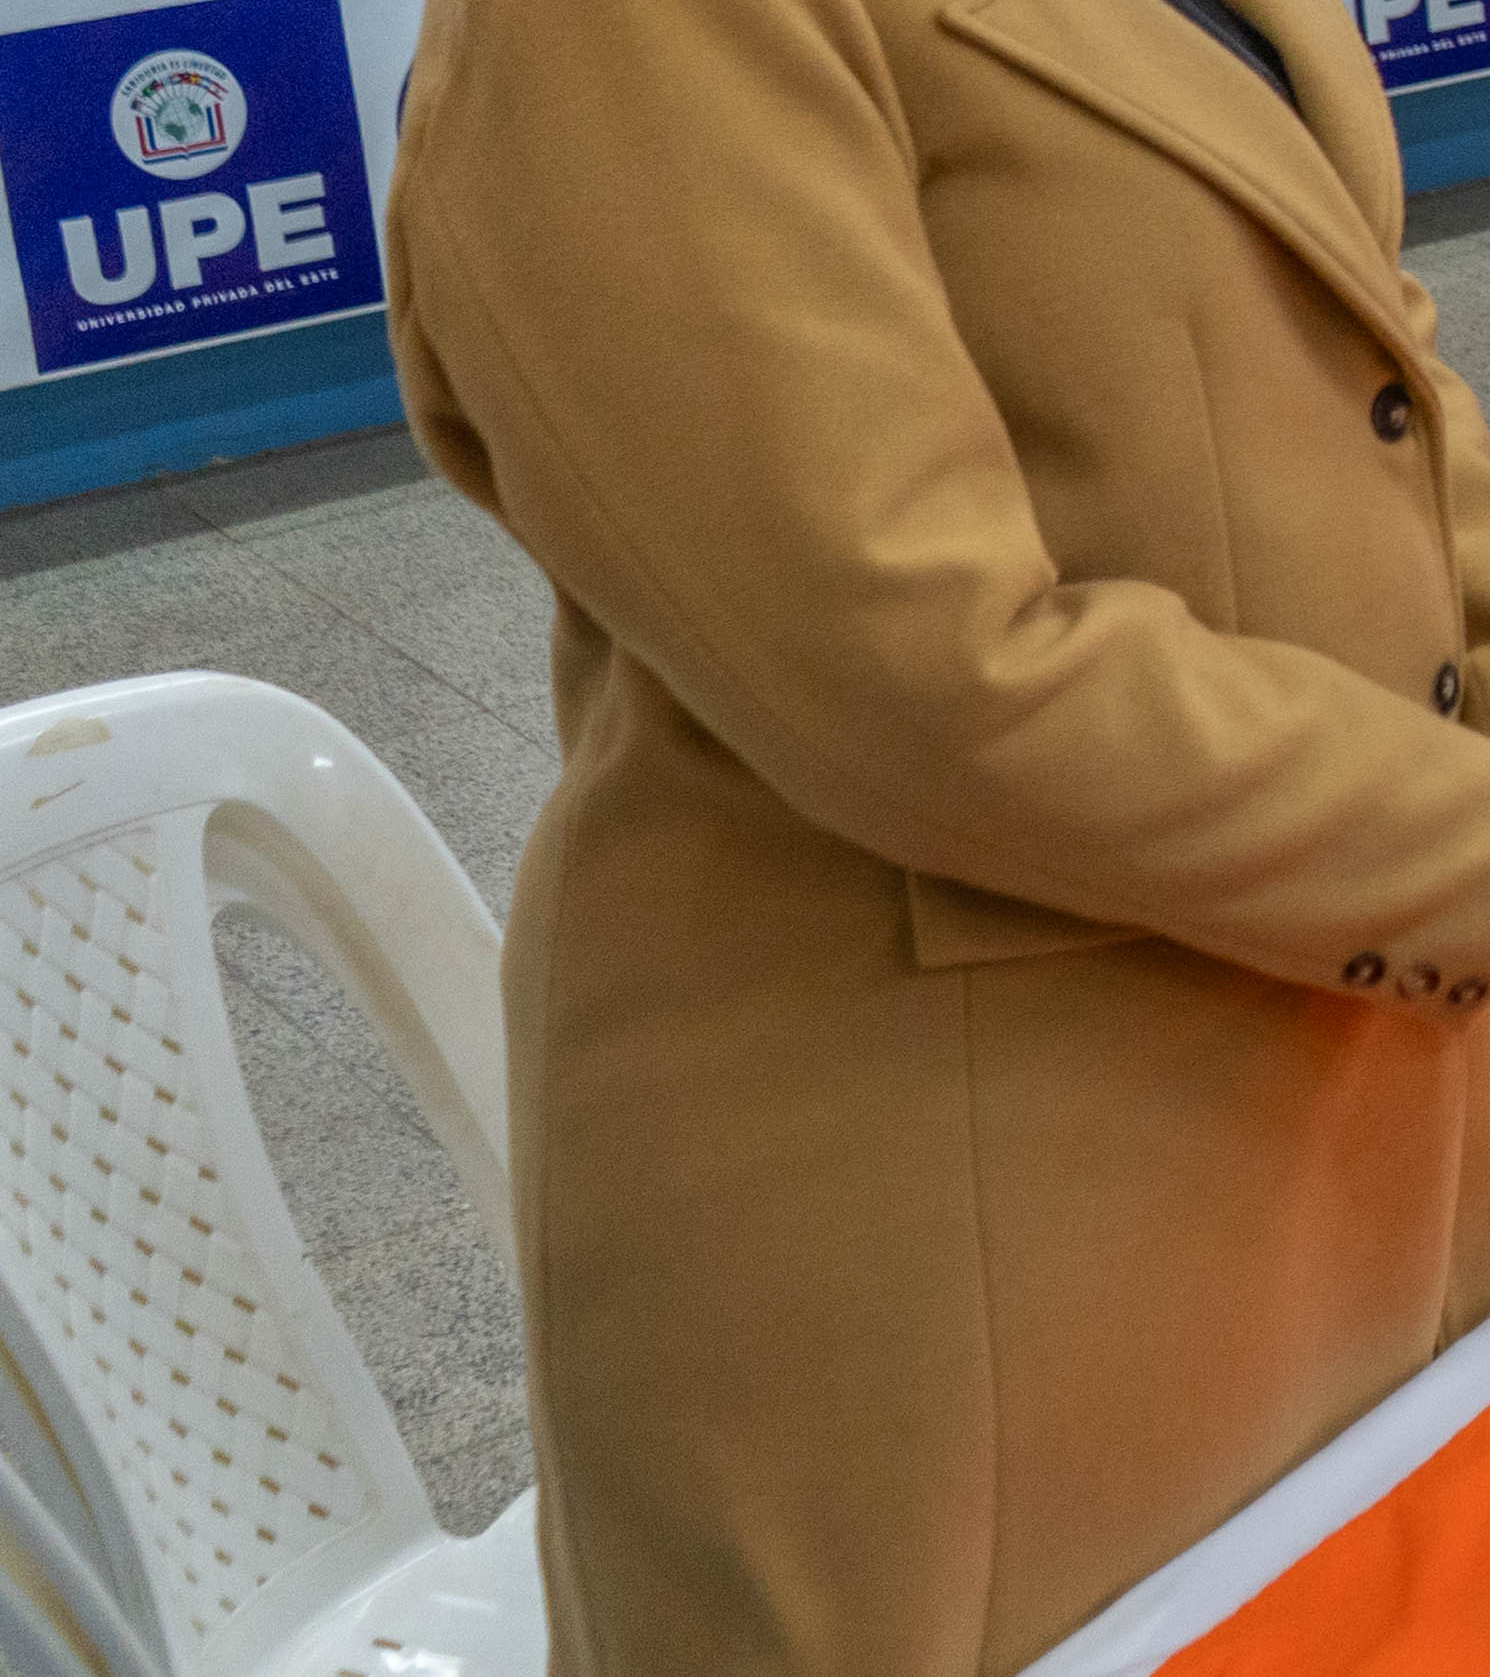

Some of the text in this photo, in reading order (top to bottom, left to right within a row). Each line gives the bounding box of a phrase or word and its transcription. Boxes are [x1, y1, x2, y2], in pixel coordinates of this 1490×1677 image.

[59, 172, 336, 306] UPE
[78, 267, 340, 332] UNIVERSIDAD PRIVADA DEL ESTE
